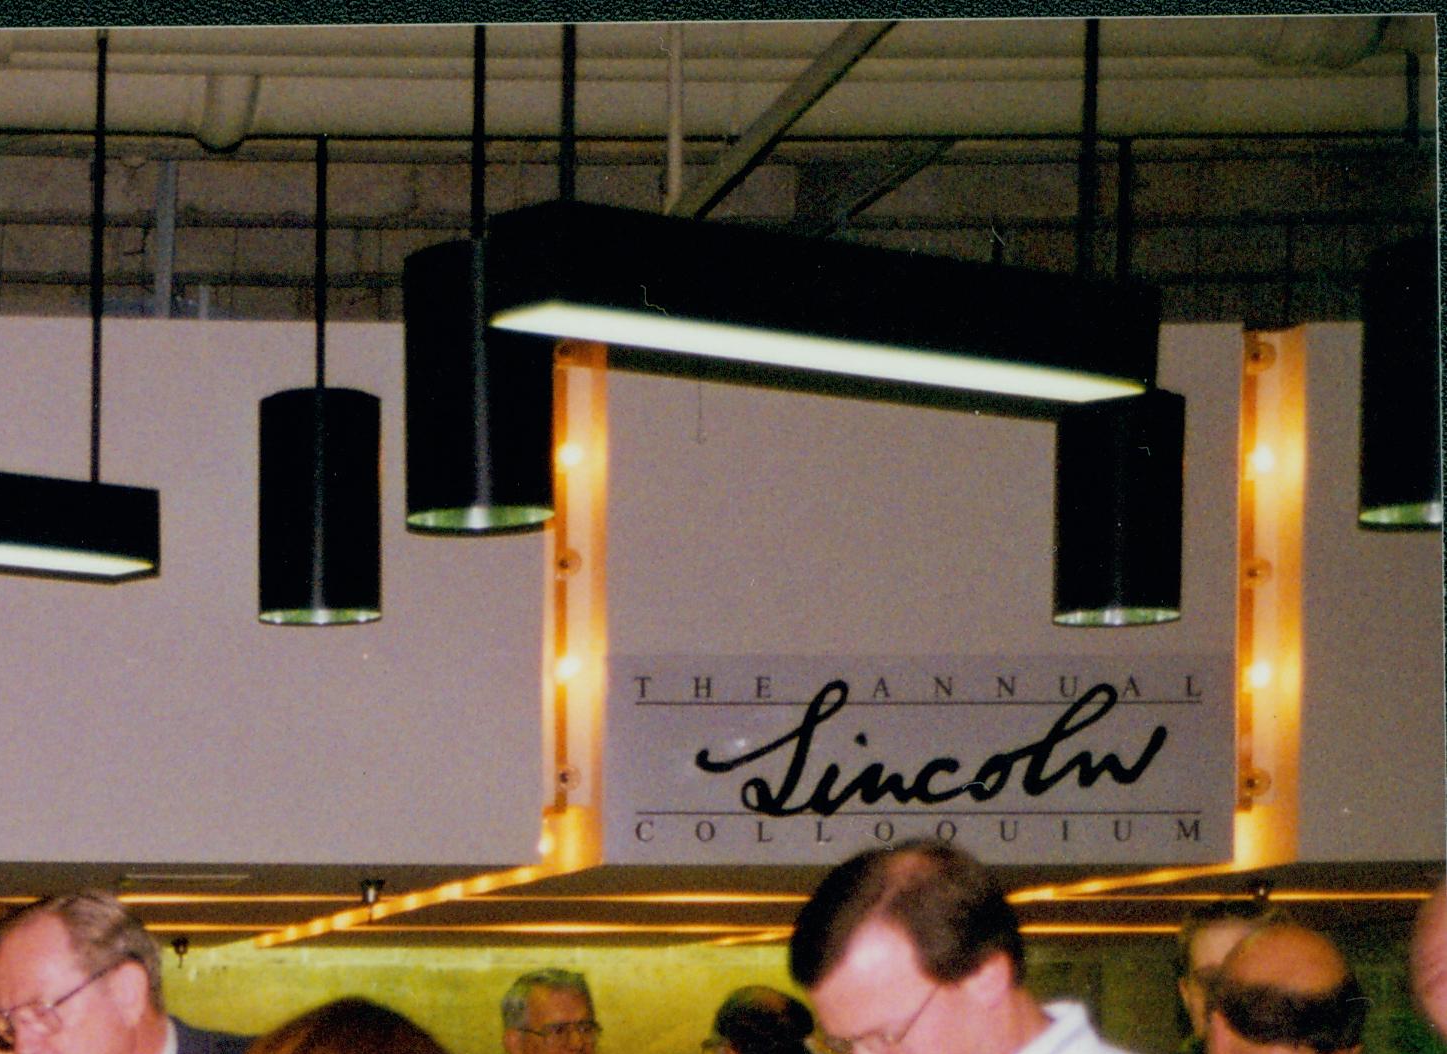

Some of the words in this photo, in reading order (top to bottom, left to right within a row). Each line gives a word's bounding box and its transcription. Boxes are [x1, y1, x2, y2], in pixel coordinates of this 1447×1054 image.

[634, 676, 771, 699] THE
[873, 675, 1201, 698] ANNUAL
[694, 679, 1167, 816] Lincoln
[635, 819, 1200, 843] COLLOQUIUM
